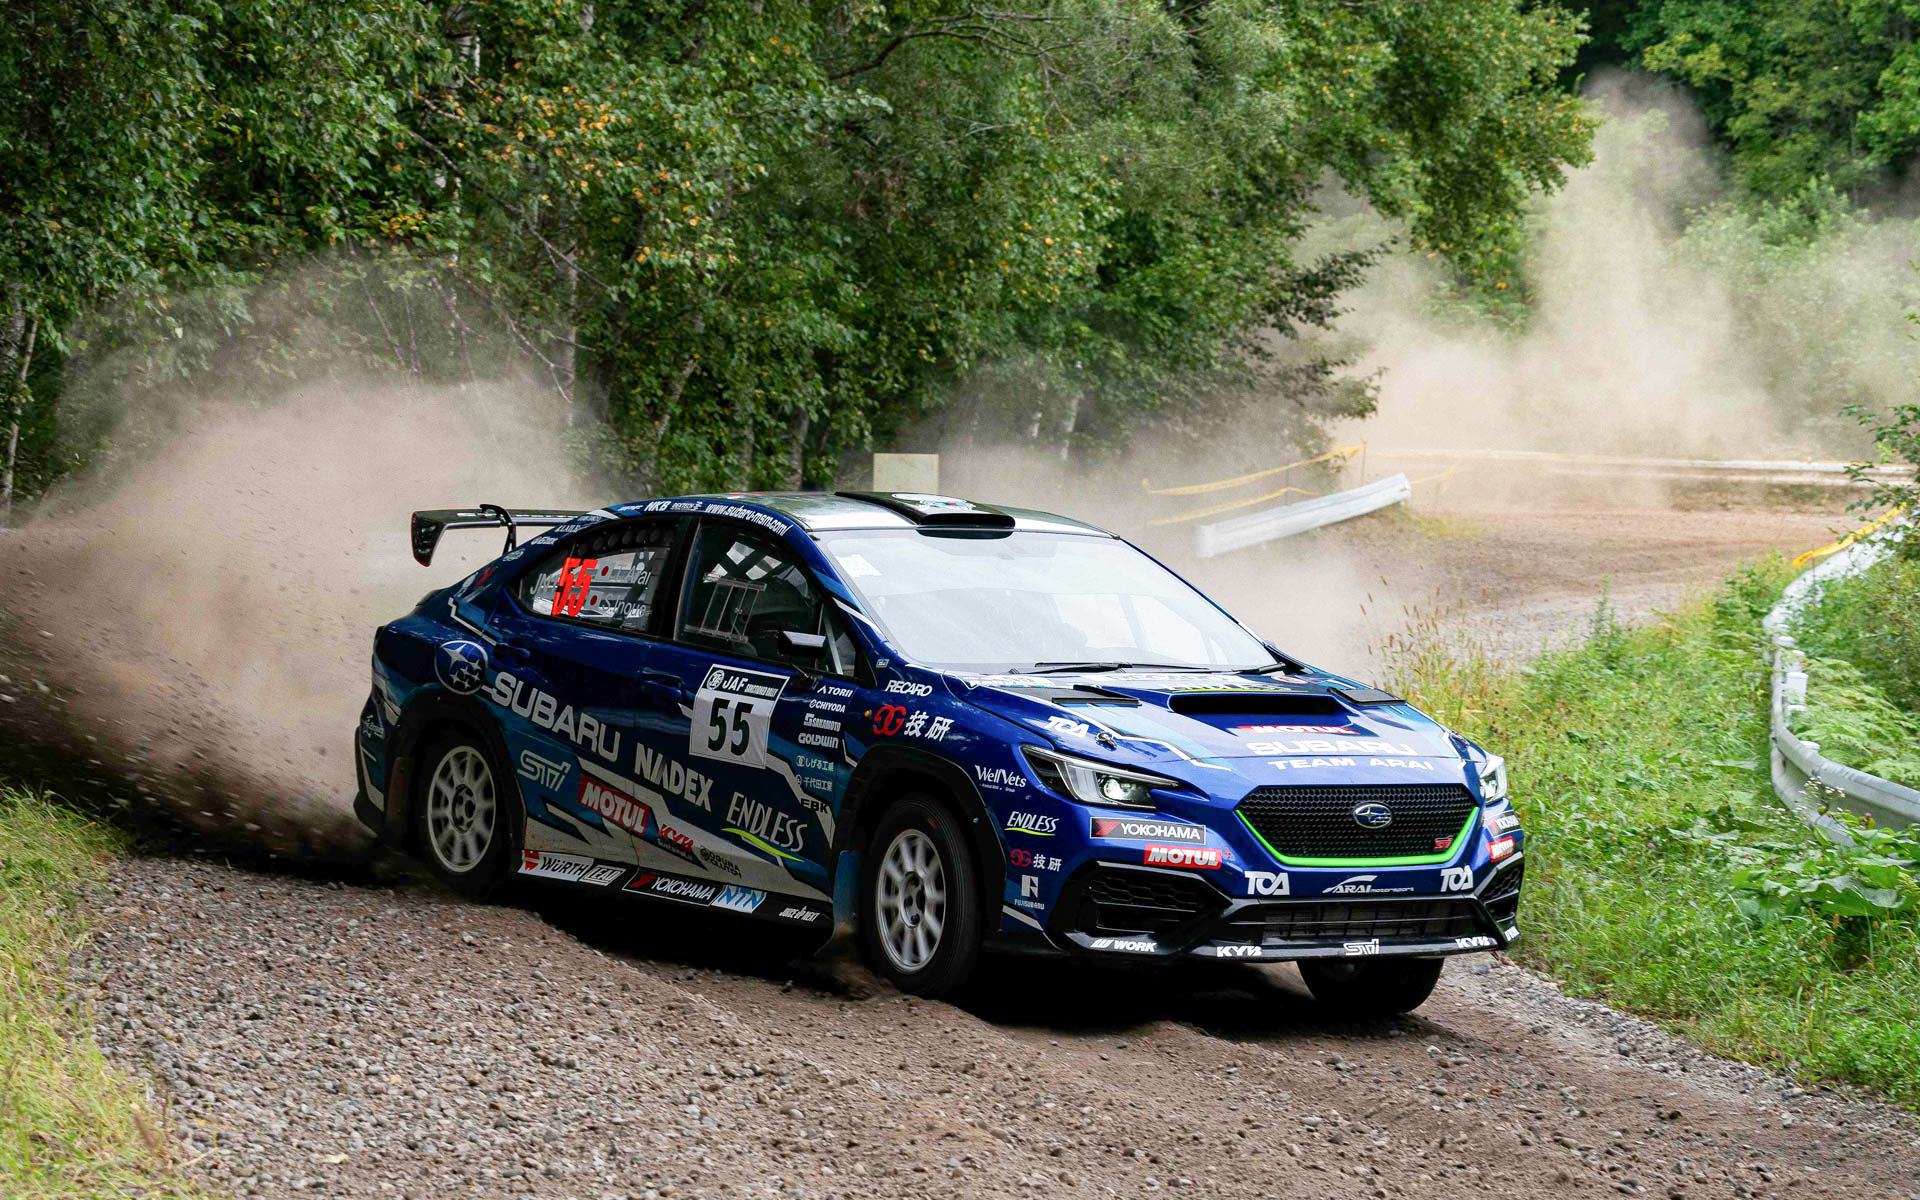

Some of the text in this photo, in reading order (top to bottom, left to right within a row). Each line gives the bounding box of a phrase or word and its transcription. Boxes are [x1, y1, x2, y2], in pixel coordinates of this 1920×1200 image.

[551, 557, 598, 616] 55
[722, 675, 749, 692] JAF
[884, 680, 933, 697] RECARO
[491, 671, 621, 762] SUBARU
[815, 700, 846, 713] CHIYODA
[707, 698, 754, 756] 55
[904, 709, 955, 742] 技研
[1043, 715, 1090, 738] TOA
[798, 732, 839, 749] GOLDWIN
[1246, 740, 1418, 756] SUBARU
[1268, 757, 1434, 771] TEAM ARAI
[634, 742, 714, 812] NADEX
[581, 782, 646, 835] MOTUL
[801, 798, 828, 814] EBK
[726, 791, 808, 852] ENDLESS
[1006, 810, 1060, 834] ENDLESS
[1121, 823, 1200, 840] YOKOHAMA
[541, 856, 587, 877] WÜRTH
[1033, 854, 1062, 872] 技研
[1148, 847, 1220, 867] MOTUL
[651, 876, 716, 901] YOKOHAMA
[1244, 870, 1290, 896] TOA
[1440, 865, 1474, 892] TOA
[717, 888, 764, 909] NTN
[1332, 884, 1373, 894] ARAI
[1113, 940, 1158, 952] WORK
[1217, 945, 1262, 958] KYB
[1455, 936, 1490, 949] KYB
